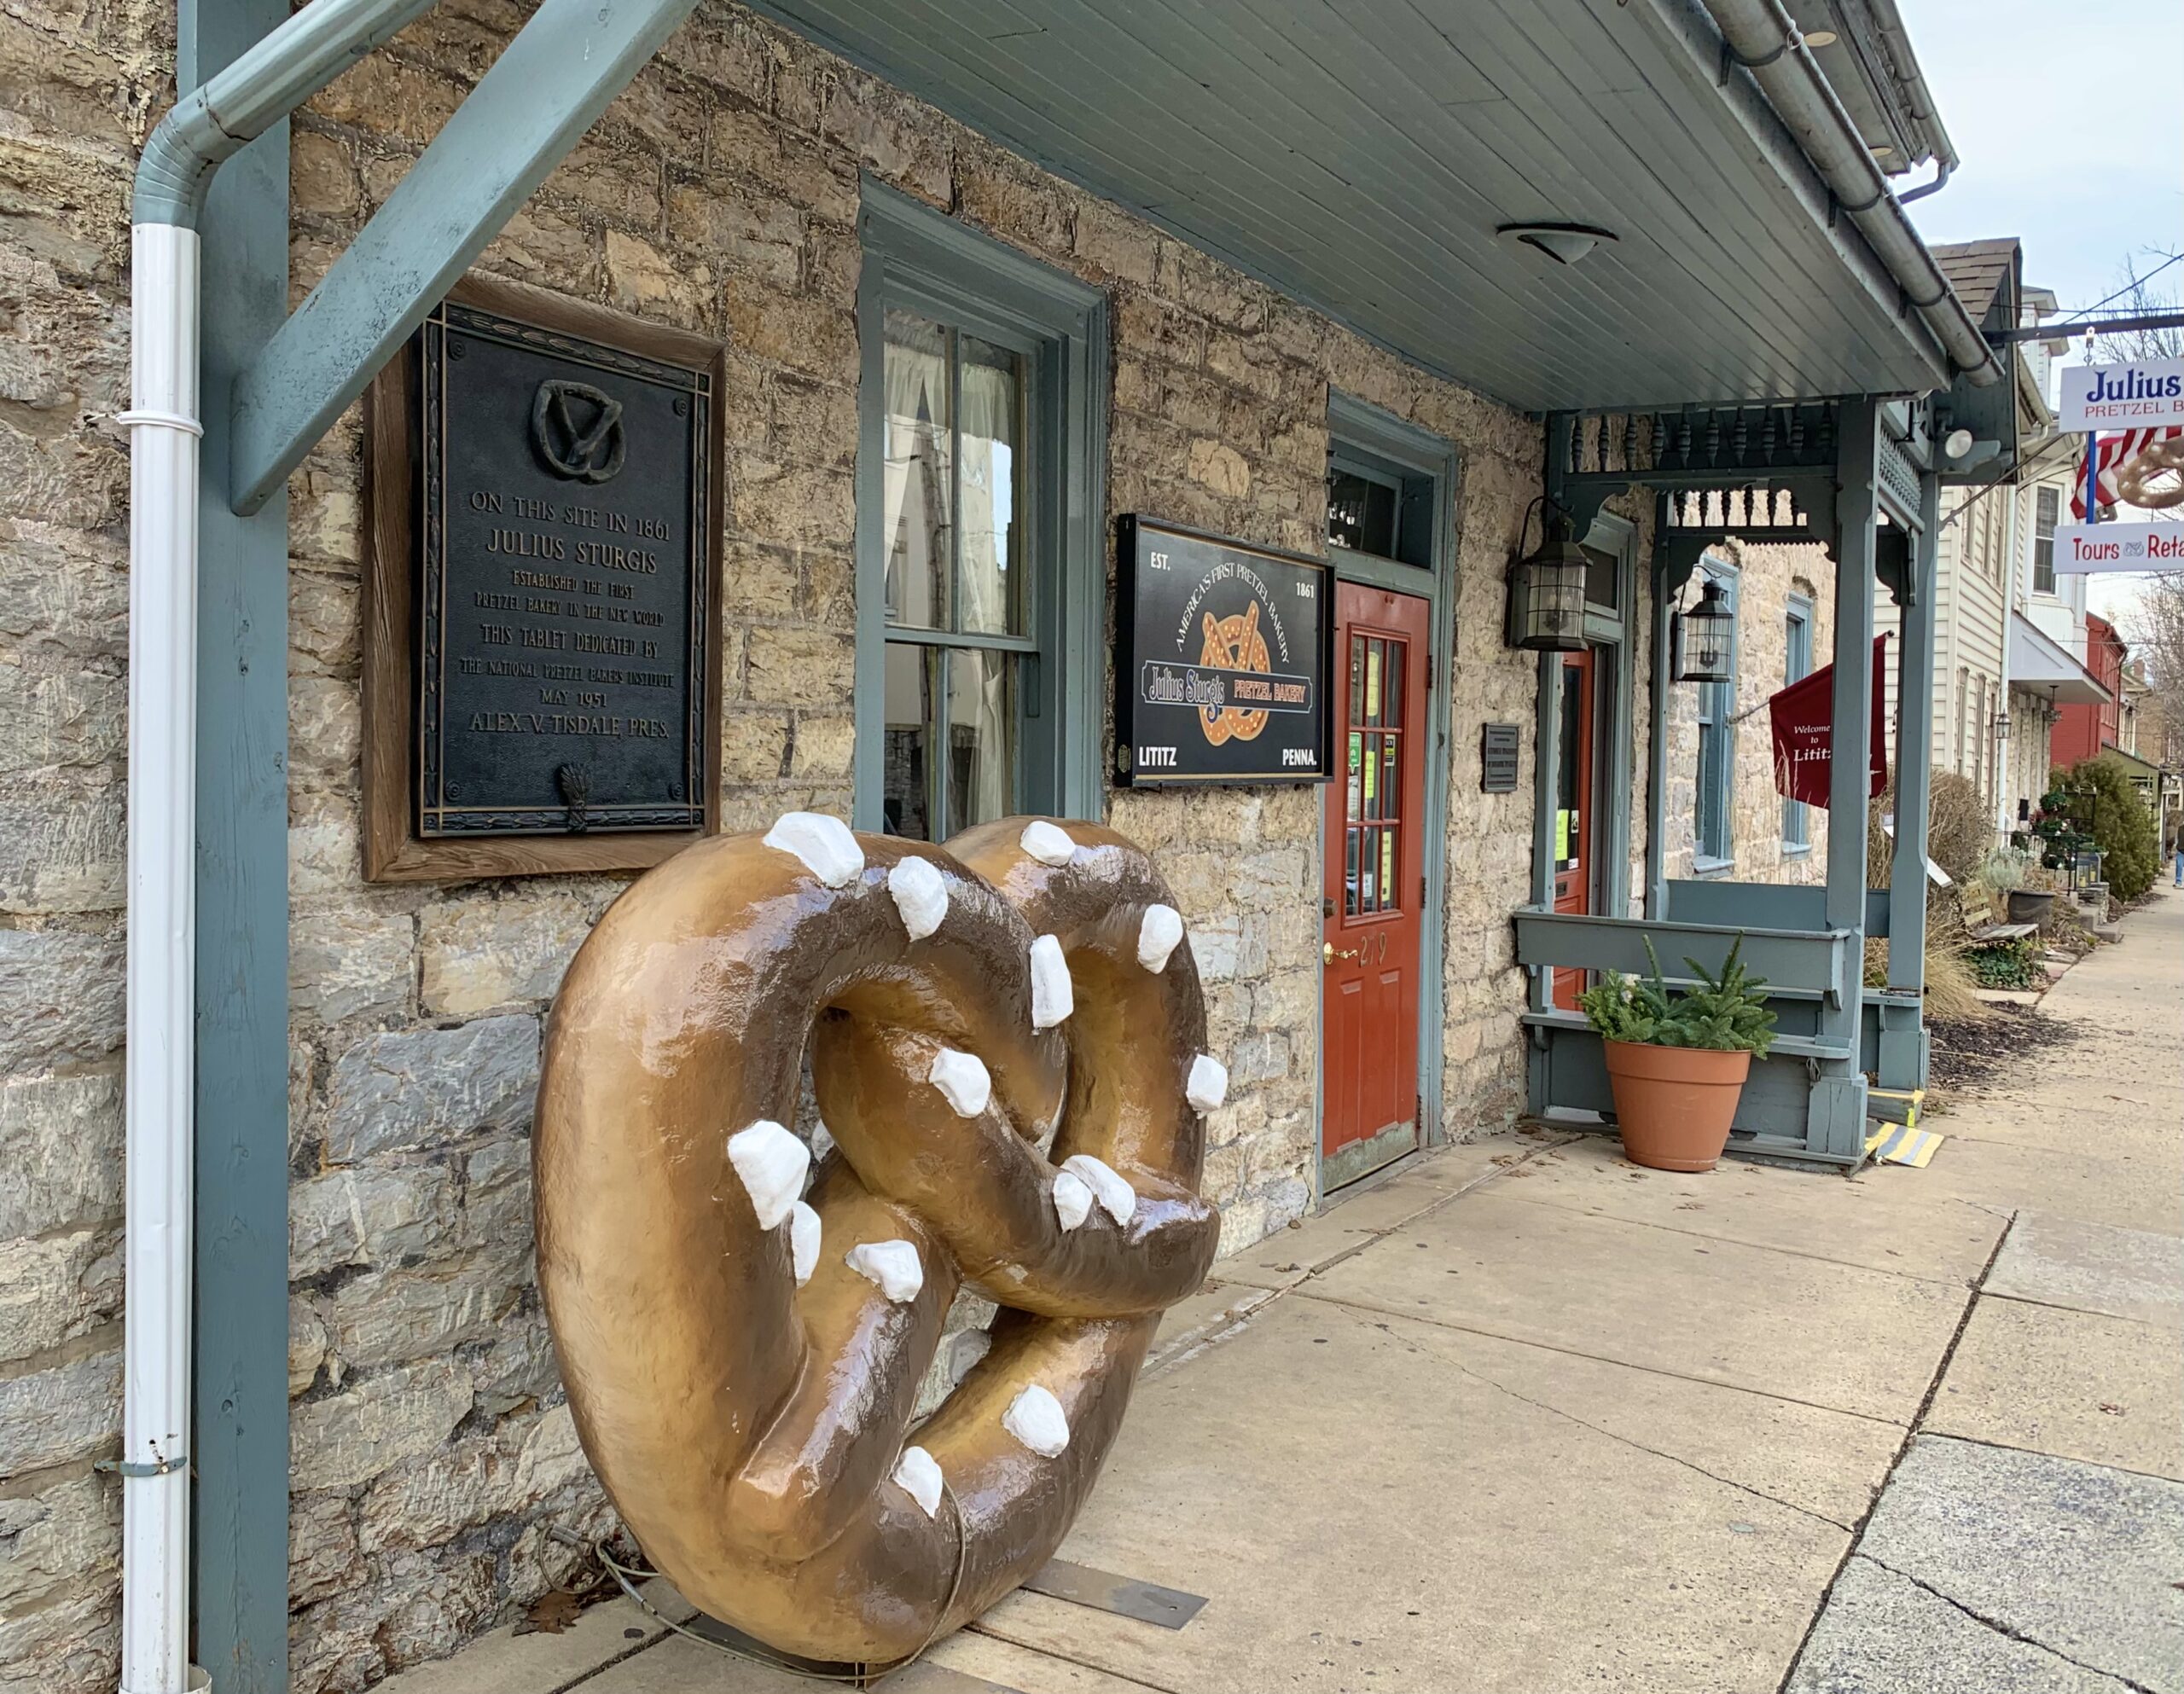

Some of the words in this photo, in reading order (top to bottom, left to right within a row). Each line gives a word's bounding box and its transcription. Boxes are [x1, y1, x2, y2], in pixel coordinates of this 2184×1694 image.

[2087, 368, 2181, 403] Julius
[2085, 402, 2164, 418] PRETZEL
[471, 490, 503, 513] ON
[514, 496, 555, 521] THIS
[565, 506, 600, 530] SITE
[607, 512, 628, 534] IN
[636, 518, 670, 541] 1861
[486, 529, 565, 560] JULIUS
[577, 541, 657, 574] STURGIS
[1150, 552, 1171, 571] EST.
[2072, 537, 2120, 561] Tours
[513, 570, 578, 592] ESTABLISHED
[584, 580, 602, 595] THE
[609, 583, 635, 600] FIRST
[1296, 582, 1315, 599] 1861
[475, 592, 521, 612] PRETZEL
[526, 597, 563, 616] BAKERY
[568, 601, 580, 617] IN
[584, 603, 604, 620] THE
[608, 606, 629, 623] NEW
[633, 610, 665, 628] WORLD
[1176, 574, 1211, 653] AMERICA'S
[1211, 562, 1235, 584] FIRST
[1236, 563, 1269, 606] PRETZEL
[1268, 601, 1290, 664] BAKERY
[481, 624, 513, 645] THIS
[520, 628, 566, 650] TABLET
[576, 631, 636, 656] DEDICATED
[642, 640, 659, 658] BY
[460, 657, 482, 675] THE
[487, 658, 538, 679] NATIONAL
[543, 663, 584, 681] PRETZEL
[627, 670, 674, 688] INSTITUTE
[540, 688, 568, 705] MAY
[577, 692, 608, 708] 1951
[1149, 665, 1184, 702] Julius
[1185, 668, 1225, 723] Sturgis
[1234, 679, 1272, 701] PRETZEL
[1274, 682, 1306, 704] BAKERY
[530, 714, 544, 734] V.
[628, 718, 671, 740] PRES.
[1794, 725, 1830, 734] Welcome
[1138, 746, 1177, 768] LITITZ
[1282, 749, 1317, 767] PENNA.
